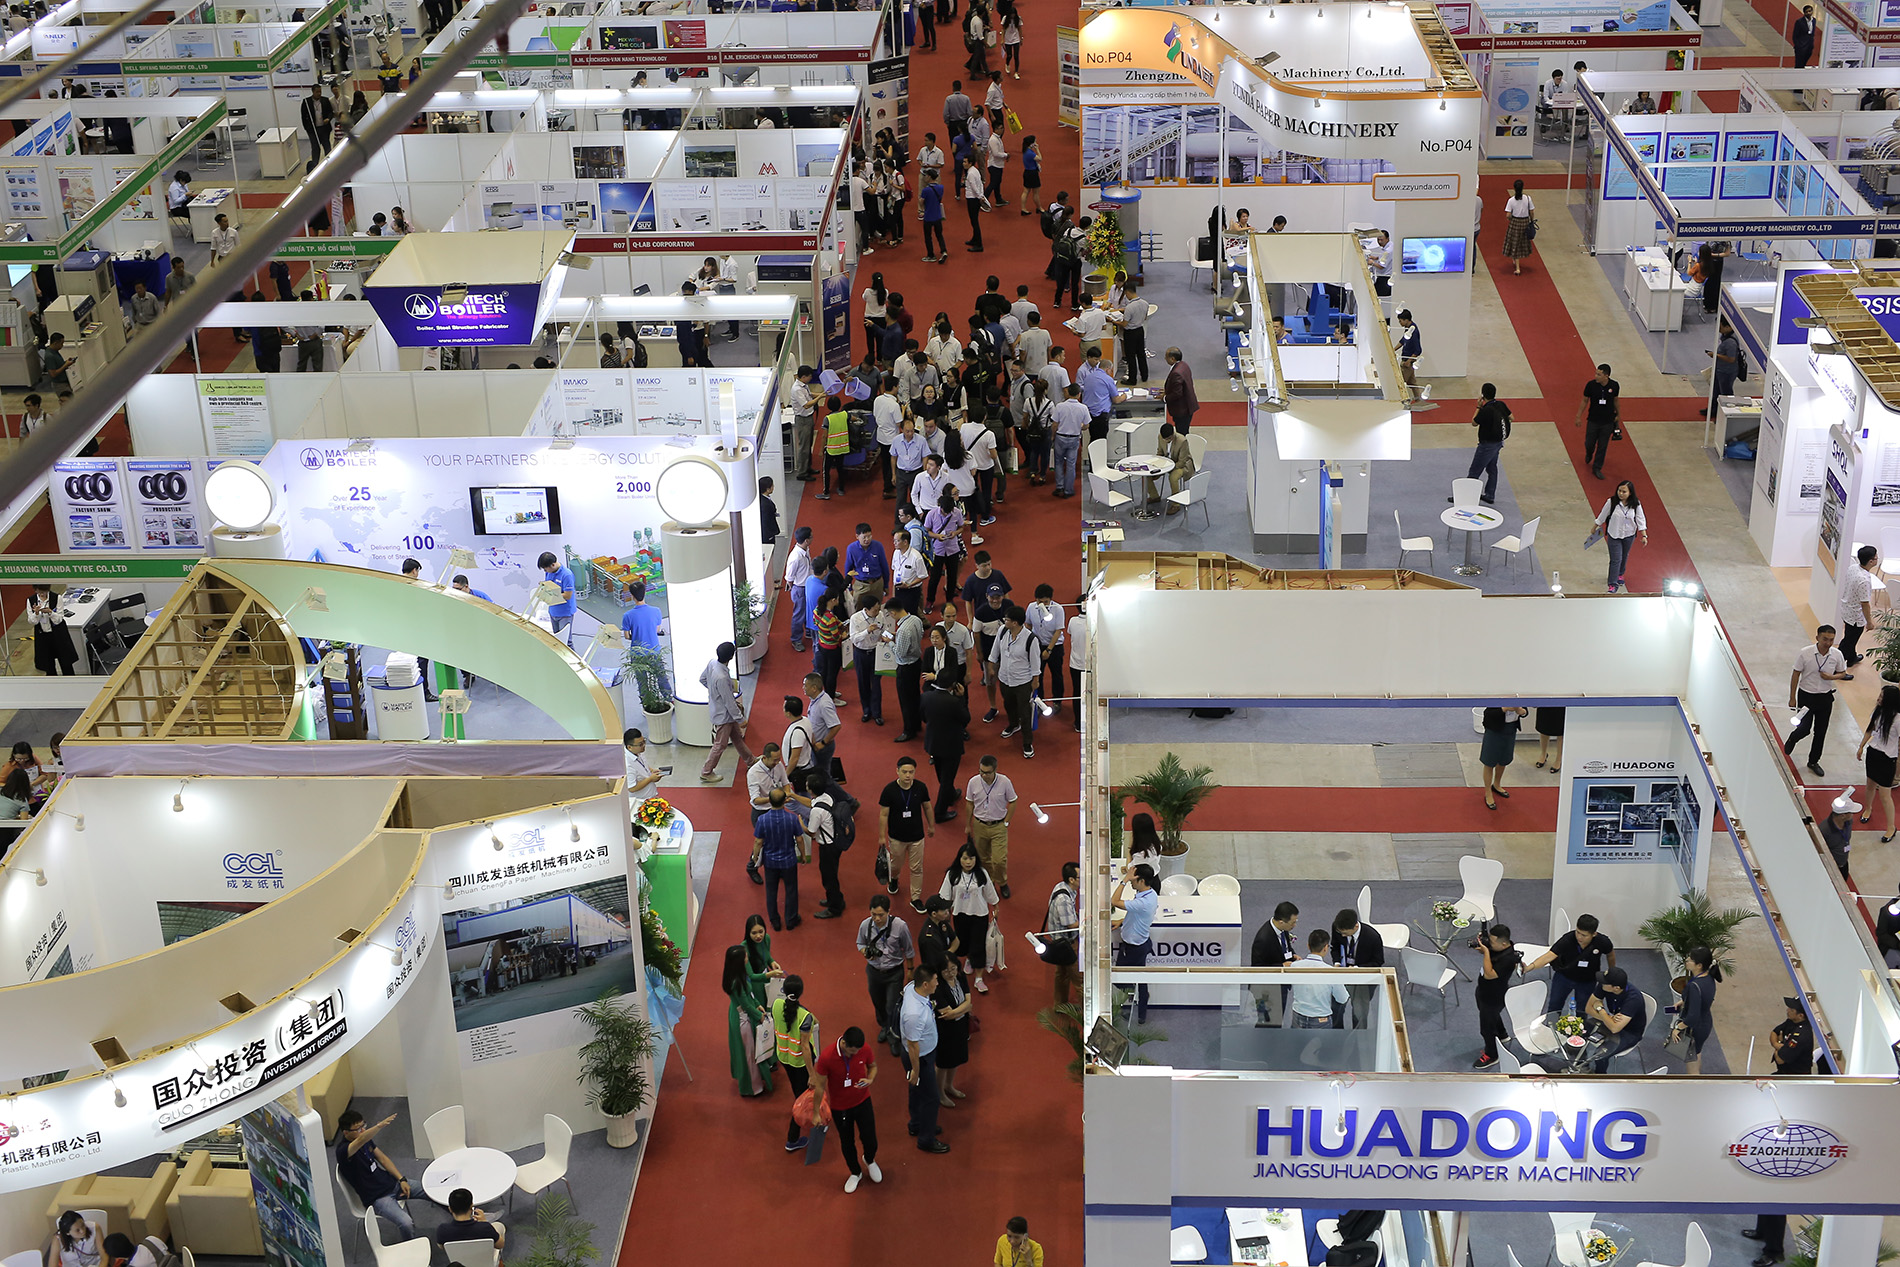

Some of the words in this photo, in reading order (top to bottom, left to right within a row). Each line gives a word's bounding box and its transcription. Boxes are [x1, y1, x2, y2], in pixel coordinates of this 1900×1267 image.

[1086, 51, 1132, 64] No.P04
[1283, 68, 1352, 79] Machinery
[1356, 66, 1406, 77] Co.,Ltd.
[1118, 90, 1137, 99] Yunda
[1138, 91, 1154, 99] cung
[1232, 80, 1255, 112] YUNDA
[1256, 98, 1281, 128] PAPER
[1284, 115, 1400, 138] MACHINERY
[1420, 139, 1473, 153] No.P04
[1382, 182, 1450, 192] www.zzyunda.com
[1679, 226, 1719, 234] BAODINGSHI
[1719, 225, 1744, 233] WEITUO
[1768, 224, 1806, 232] MACHINERY
[632, 241, 651, 249] Q-LAB
[43, 249, 56, 257] R29
[439, 303, 508, 316] BOILER
[327, 457, 377, 467] BOILER
[423, 454, 462, 467] YOUR
[466, 453, 538, 467] PARTNERS
[333, 494, 347, 502] Over
[349, 486, 371, 501] 25
[616, 481, 651, 494] 2,000
[370, 544, 401, 552] Delivering
[402, 535, 435, 550] 100
[5, 565, 40, 573] HUAXING
[42, 565, 71, 573] WANDA
[72, 565, 94, 573] TYRE
[96, 564, 128, 573] CO.,LTD
[1613, 761, 1675, 770] HUADONG
[226, 878, 285, 889] 成发纸机
[454, 887, 479, 897] ichuan
[481, 879, 513, 892] ChengFa
[515, 874, 537, 885] Paper
[541, 866, 578, 879] Machinery
[1111, 942, 1222, 957] HADONG
[264, 1043, 317, 1080] INVESTMENT
[317, 1022, 346, 1049] (GROUP)
[158, 1103, 194, 1125] GUO
[200, 1075, 256, 1109] ZHONG
[1256, 1107, 1648, 1159] HUADONG
[1749, 1145, 1827, 1157] ZAOZHIJIXIE
[1829, 1144, 1849, 1159] 东
[1, 1163, 29, 1175] Plastic
[32, 1156, 66, 1169] Machine
[1253, 1163, 1439, 1181] JIANGSUHUADONG
[1448, 1165, 1509, 1181] PAPER
[1518, 1165, 1642, 1183] MACHINERY
